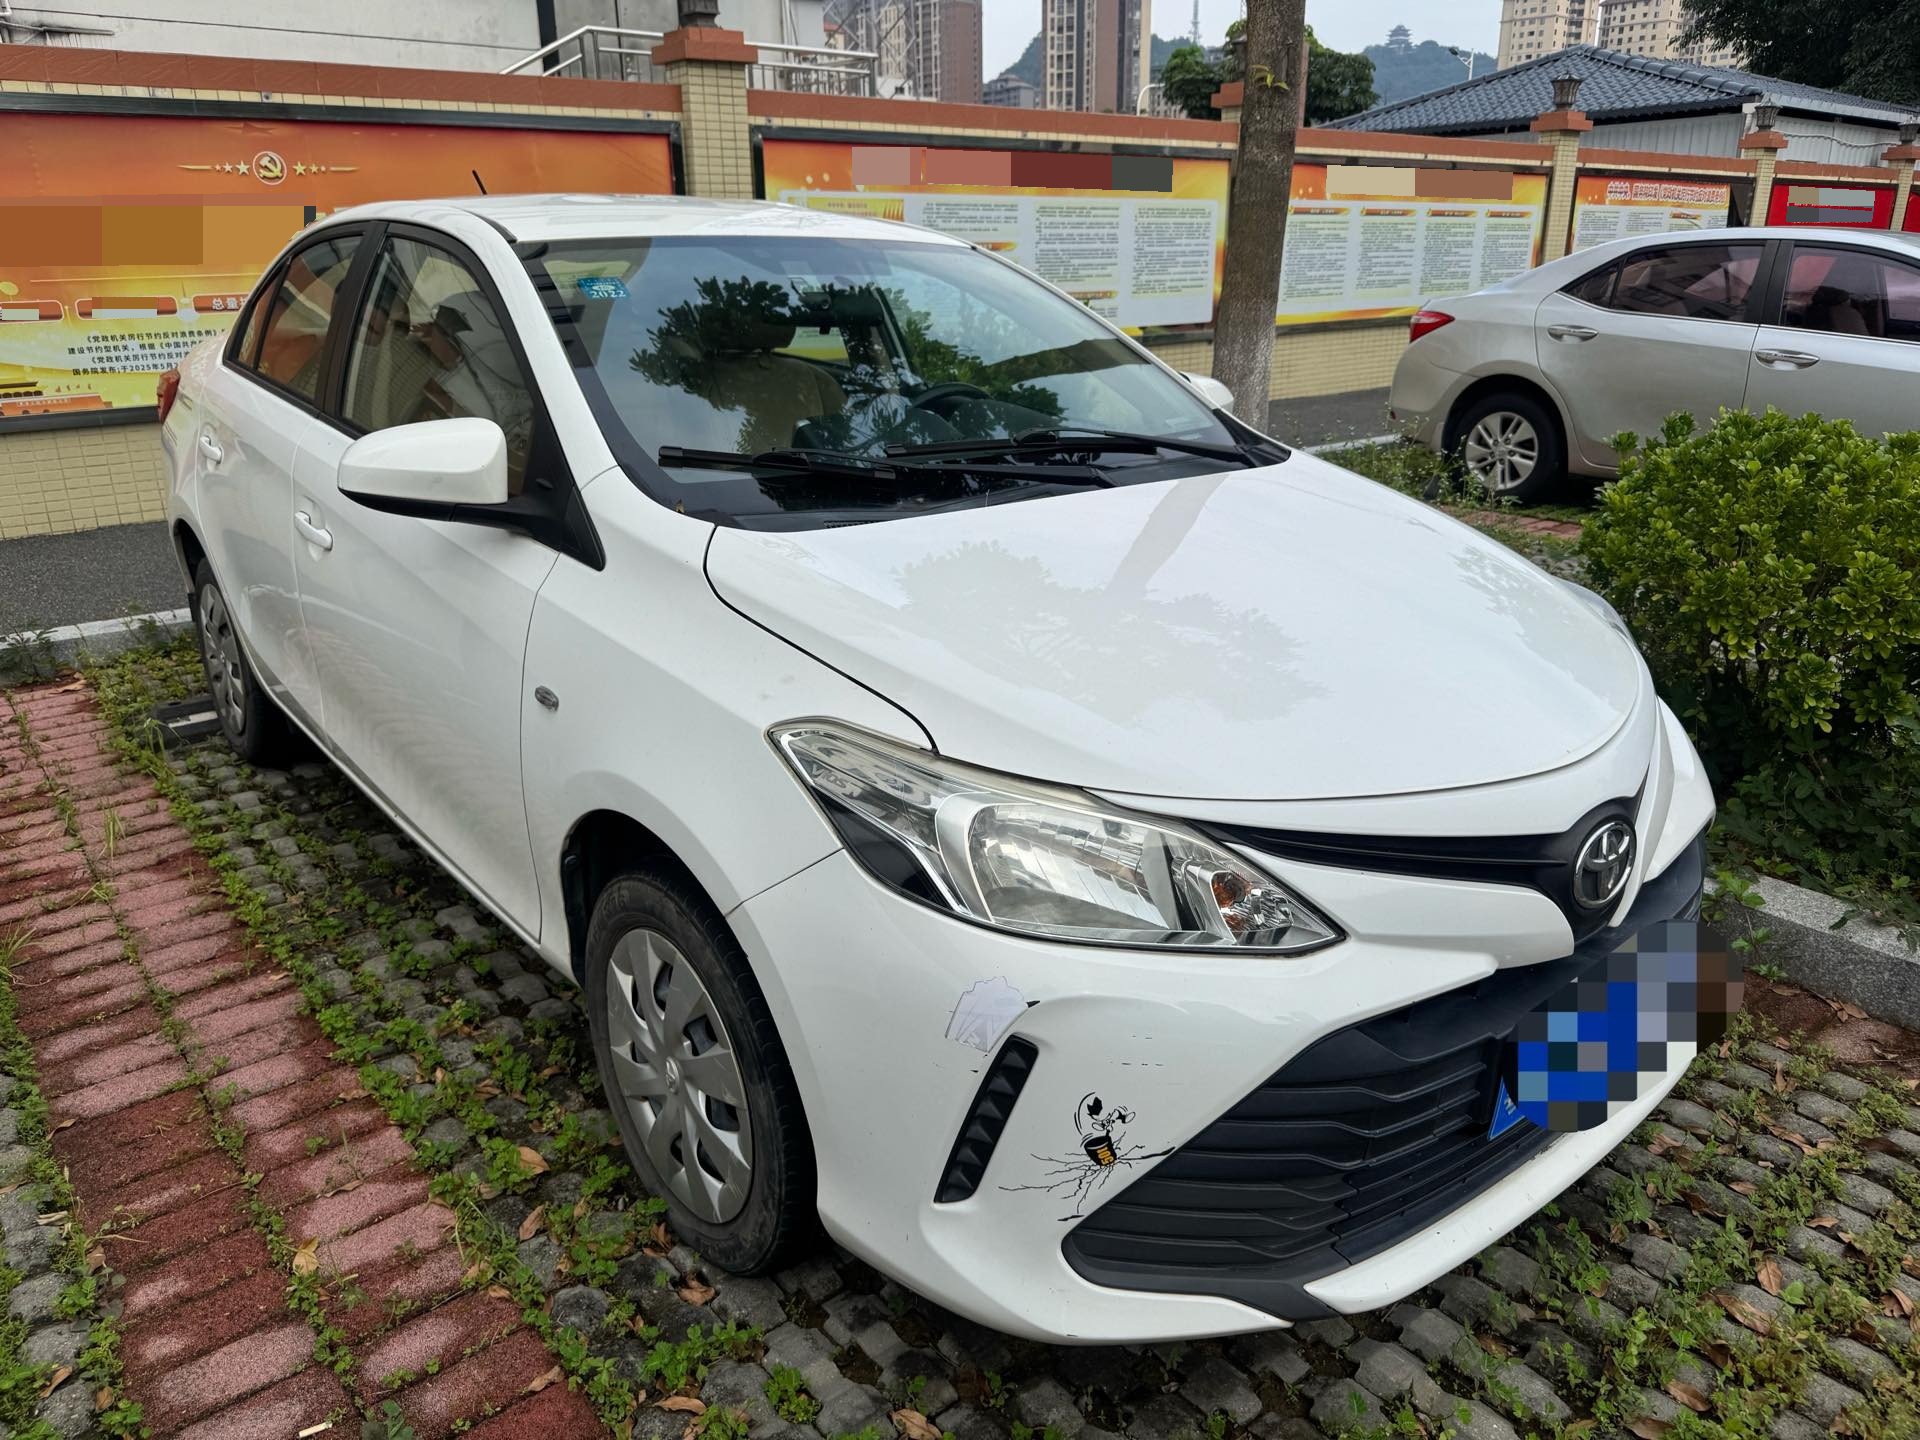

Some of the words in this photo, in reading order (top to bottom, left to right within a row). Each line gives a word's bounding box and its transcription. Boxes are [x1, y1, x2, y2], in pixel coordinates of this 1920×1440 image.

[590, 290, 626, 298] 2022
[87, 328, 226, 343] 《党政机关厉行节约反对浪费条例》
